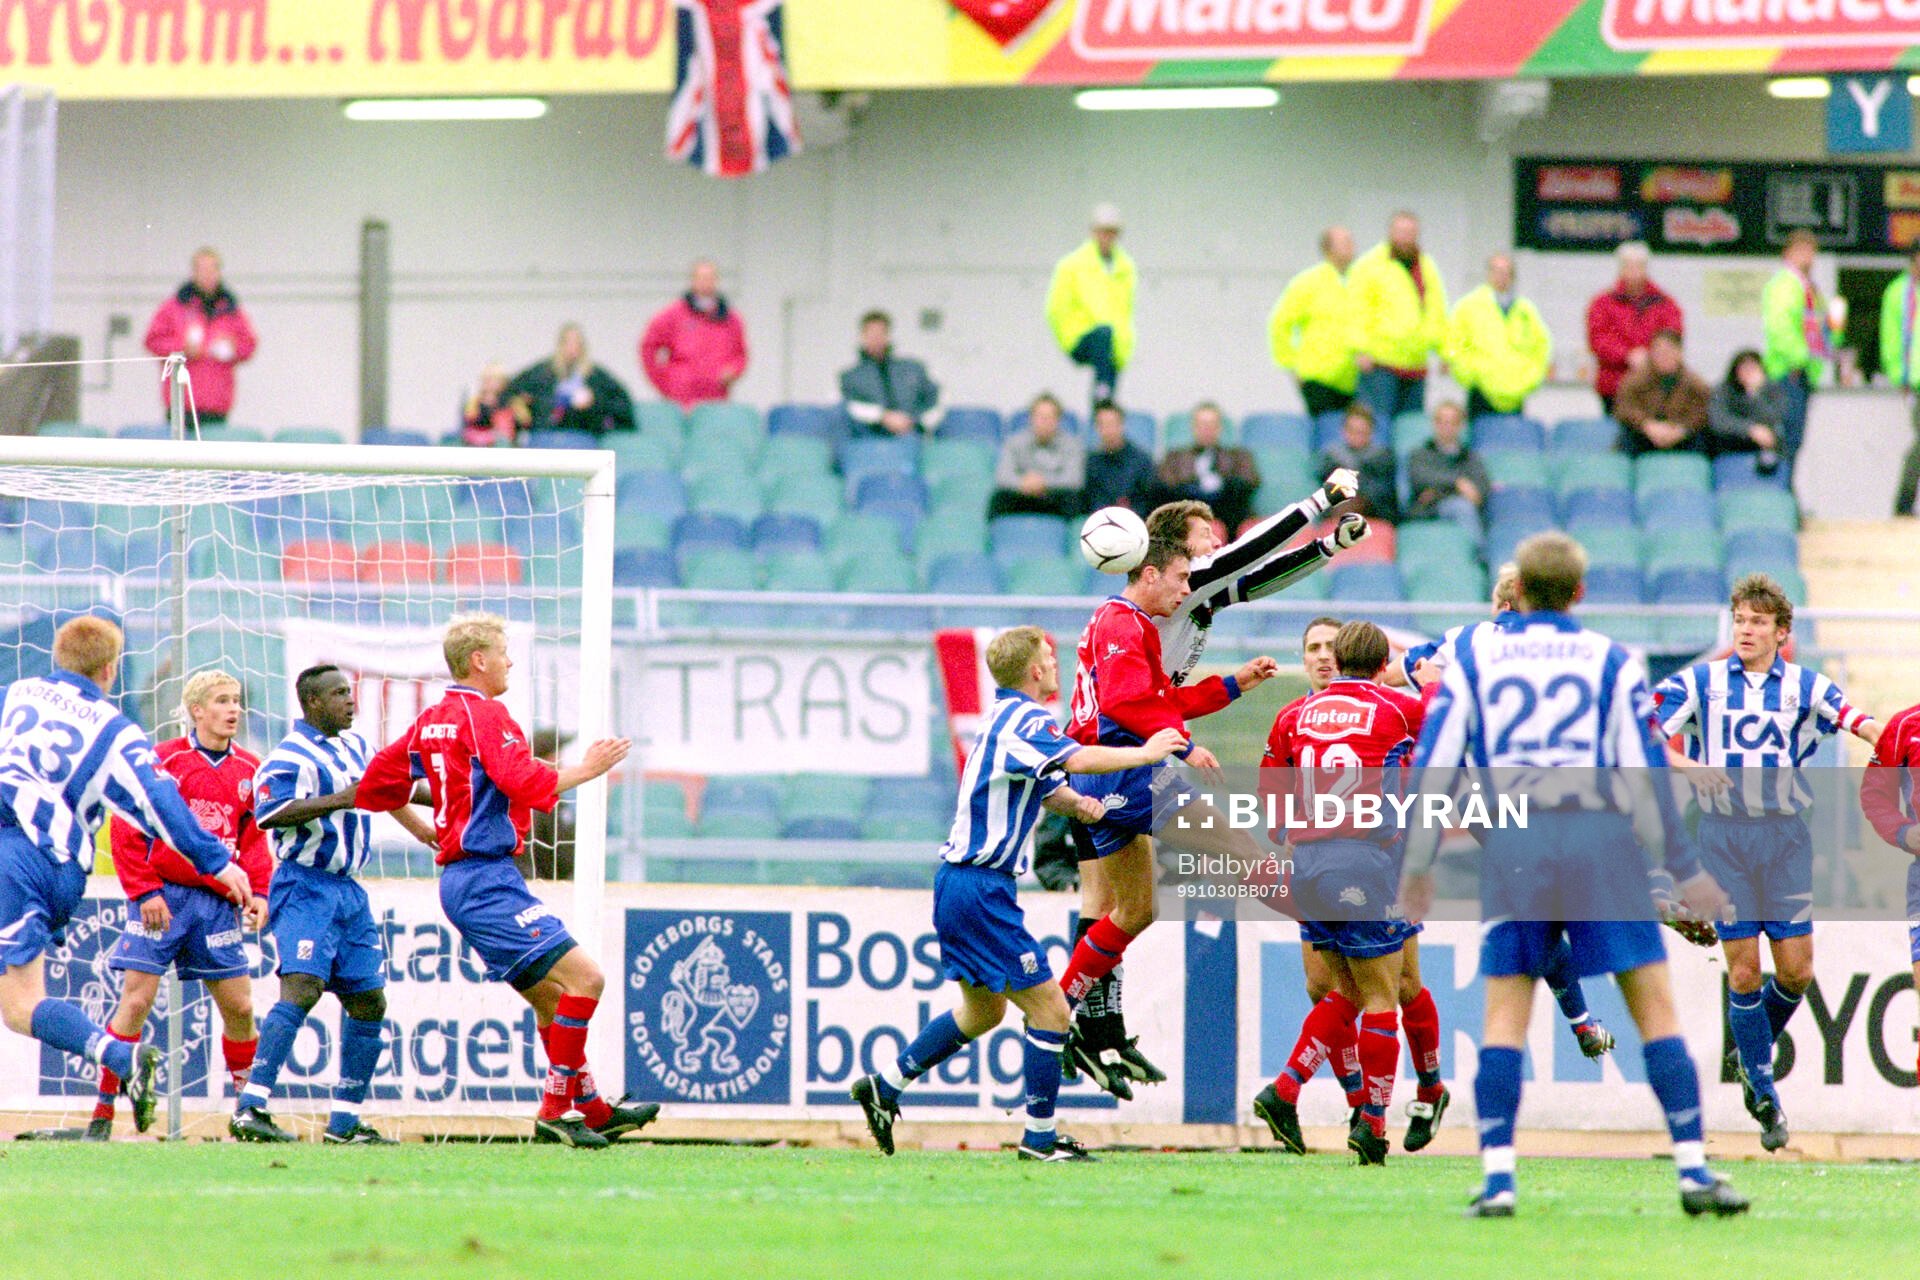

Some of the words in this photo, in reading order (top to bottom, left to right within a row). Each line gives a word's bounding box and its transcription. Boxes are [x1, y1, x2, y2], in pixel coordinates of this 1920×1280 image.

[367, 0, 664, 61] Marab
[1848, 79, 1891, 138] Y
[0, 704, 85, 783] 23
[1304, 708, 1361, 726] Lipton
[1489, 674, 1592, 755] 22
[1722, 714, 1786, 750] ICA
[630, 915, 735, 990] GÖTEBORGS
[742, 930, 788, 993] STADS
[629, 1011, 789, 1101] BOSTADSAKTIEBOLAG
